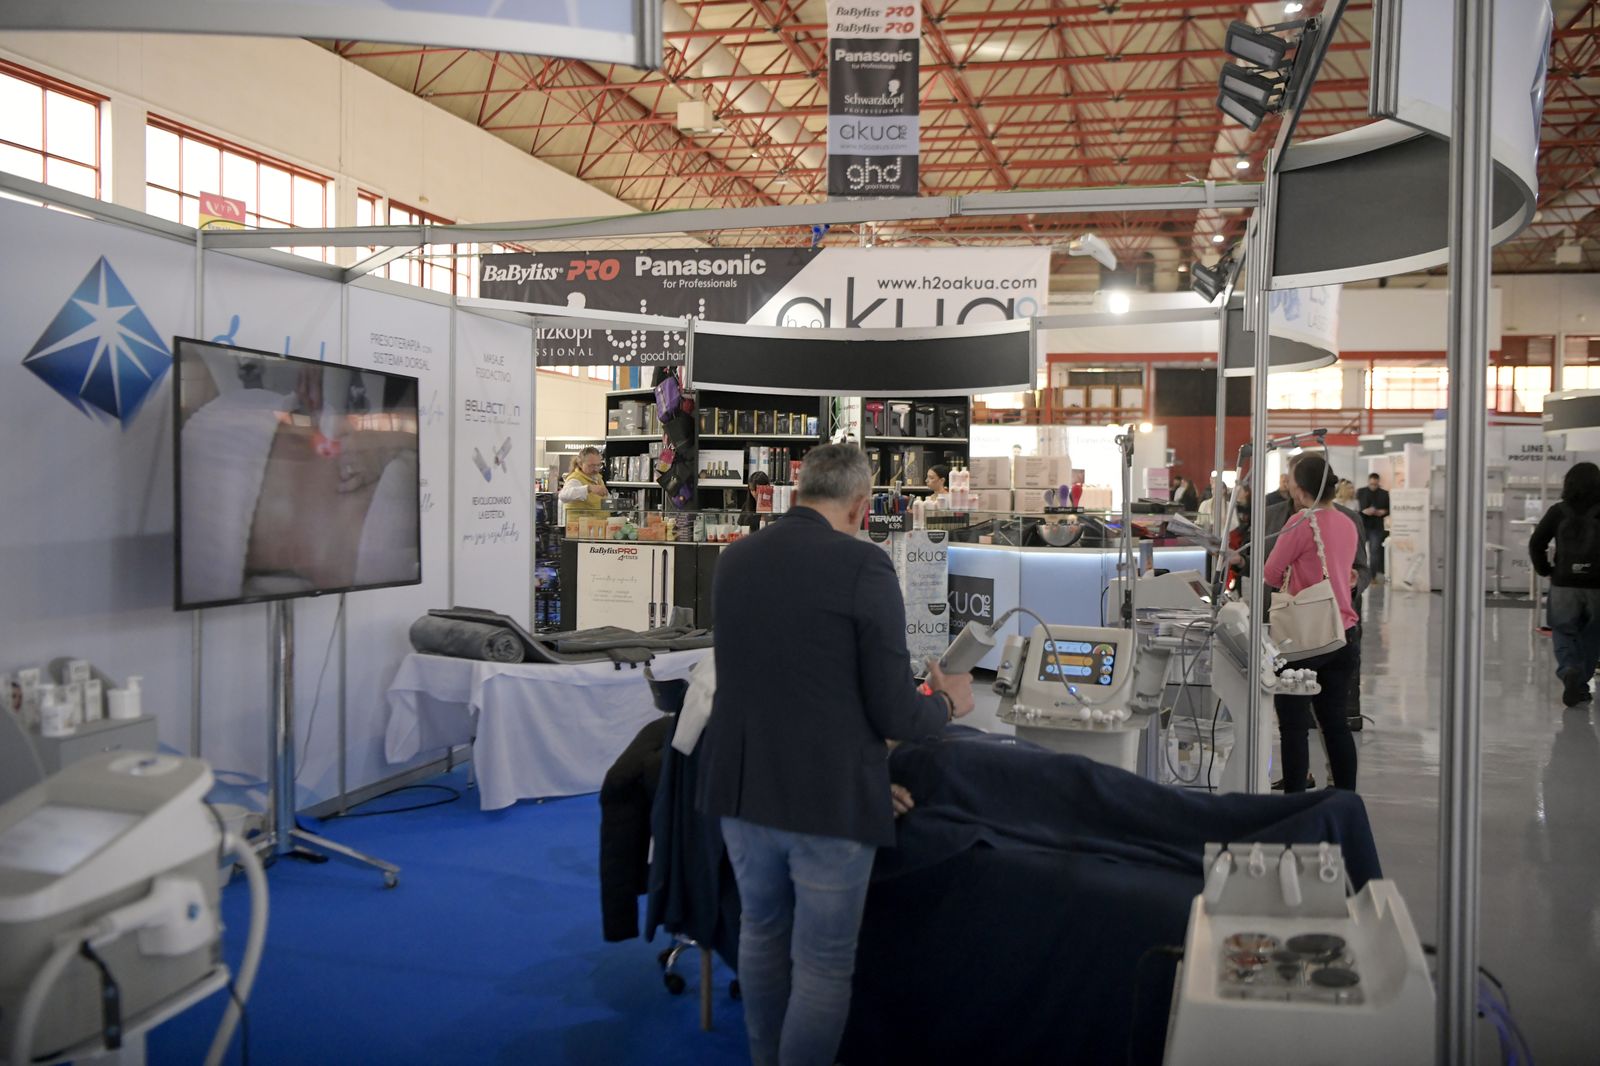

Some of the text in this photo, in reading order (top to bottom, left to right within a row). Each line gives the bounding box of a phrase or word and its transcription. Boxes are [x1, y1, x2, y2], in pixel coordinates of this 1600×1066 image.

[836, 5, 914, 18] BaByliss PRO
[835, 22, 914, 34] BaByliss PRO
[834, 48, 913, 62] Panasonic
[844, 93, 904, 109] Schwarzkopf
[839, 120, 901, 141] akua
[846, 157, 902, 190] ghd
[483, 259, 620, 285] BaByliss PRO
[635, 254, 767, 276] Panasonic
[663, 279, 738, 288] for Professionals
[877, 276, 1038, 290] www.h2oakua.com
[640, 351, 665, 364] good
[869, 515, 903, 524] TERMIX
